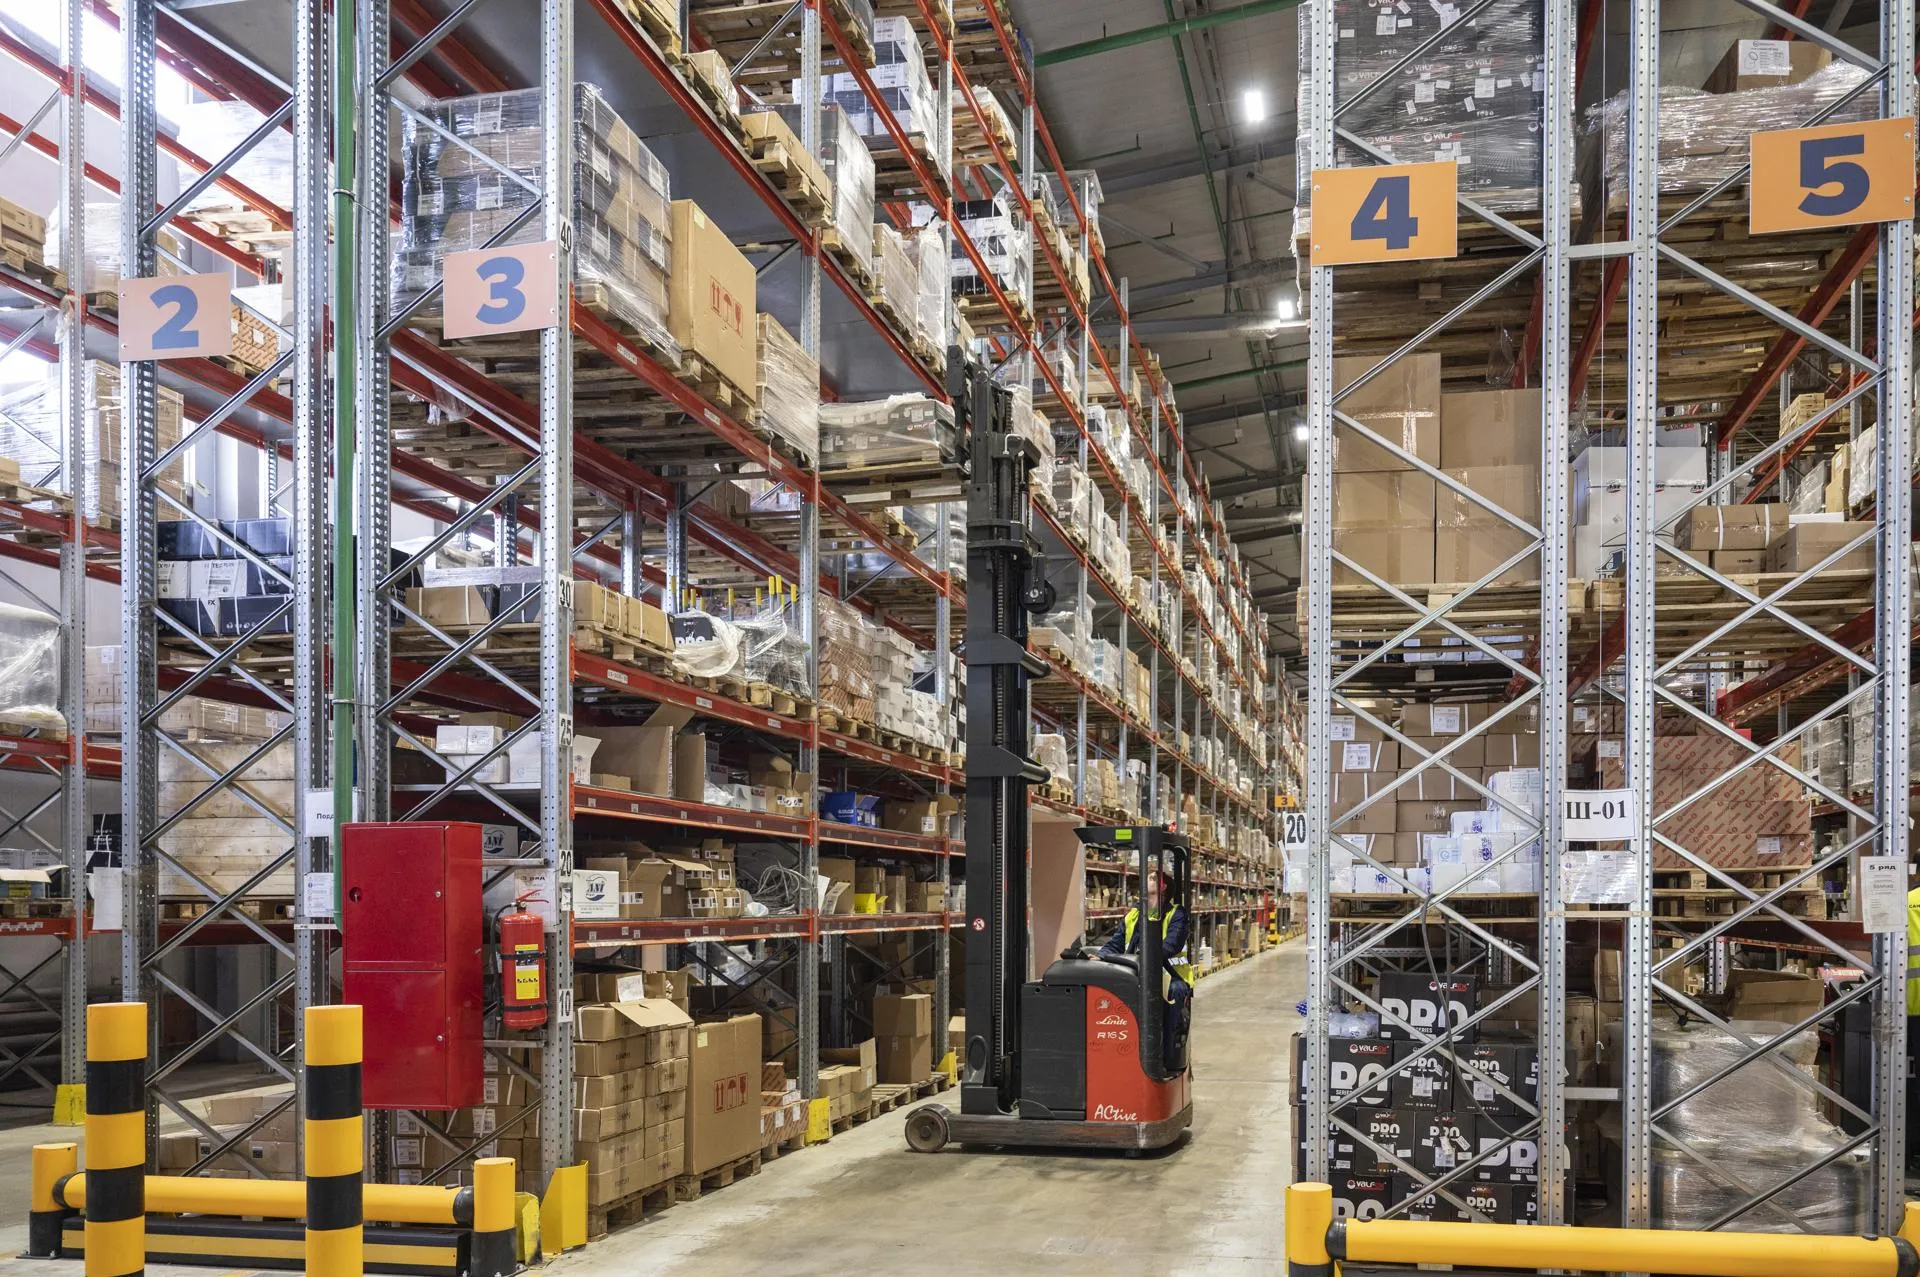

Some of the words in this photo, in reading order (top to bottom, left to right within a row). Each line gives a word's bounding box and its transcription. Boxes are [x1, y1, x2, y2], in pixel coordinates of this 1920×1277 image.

[1798, 135, 1870, 217] 5
[1350, 175, 1418, 250] 4
[560, 221, 572, 253] 40
[475, 256, 526, 325] 3
[150, 285, 199, 350] 2
[559, 579, 571, 608] 30
[561, 718, 572, 746] 25
[1281, 797, 1288, 805] 3
[1566, 800, 1627, 820] Ш-01
[1286, 814, 1307, 844] 20
[560, 850, 572, 877] 20
[560, 990, 571, 1017] 10
[1096, 1015, 1128, 1025] Linde
